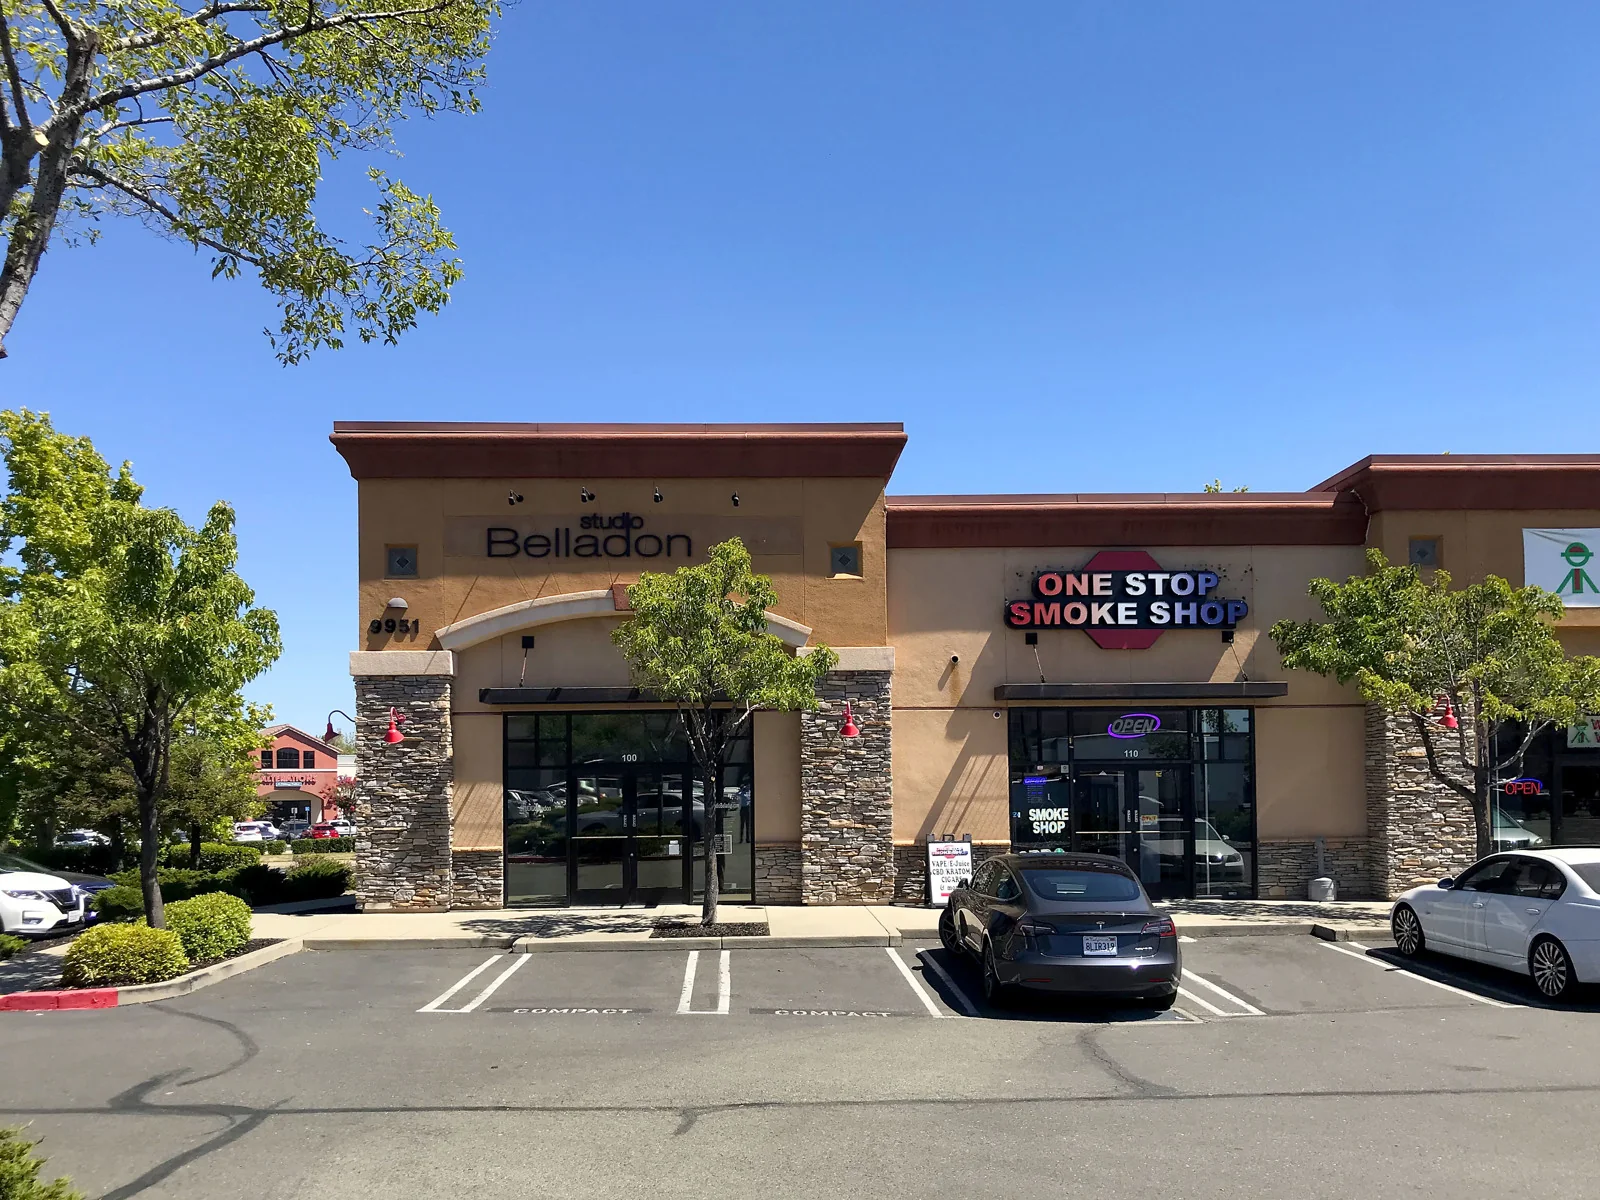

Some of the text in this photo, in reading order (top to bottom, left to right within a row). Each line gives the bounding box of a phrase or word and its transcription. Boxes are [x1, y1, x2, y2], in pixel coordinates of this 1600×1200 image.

[580, 512, 644, 529] studio
[486, 526, 692, 558] Belladon
[1037, 572, 1219, 596] ONE STOP
[1009, 601, 1249, 626] SMOKE SHOP
[370, 618, 420, 634] 9951
[1111, 718, 1155, 734] OPEN
[621, 753, 637, 762] 100
[1123, 749, 1139, 758] 110
[1504, 781, 1541, 795] OPEN
[1028, 808, 1070, 821] SMOKE
[1032, 821, 1066, 834] SHOP
[774, 1010, 892, 1018] COMPACT
